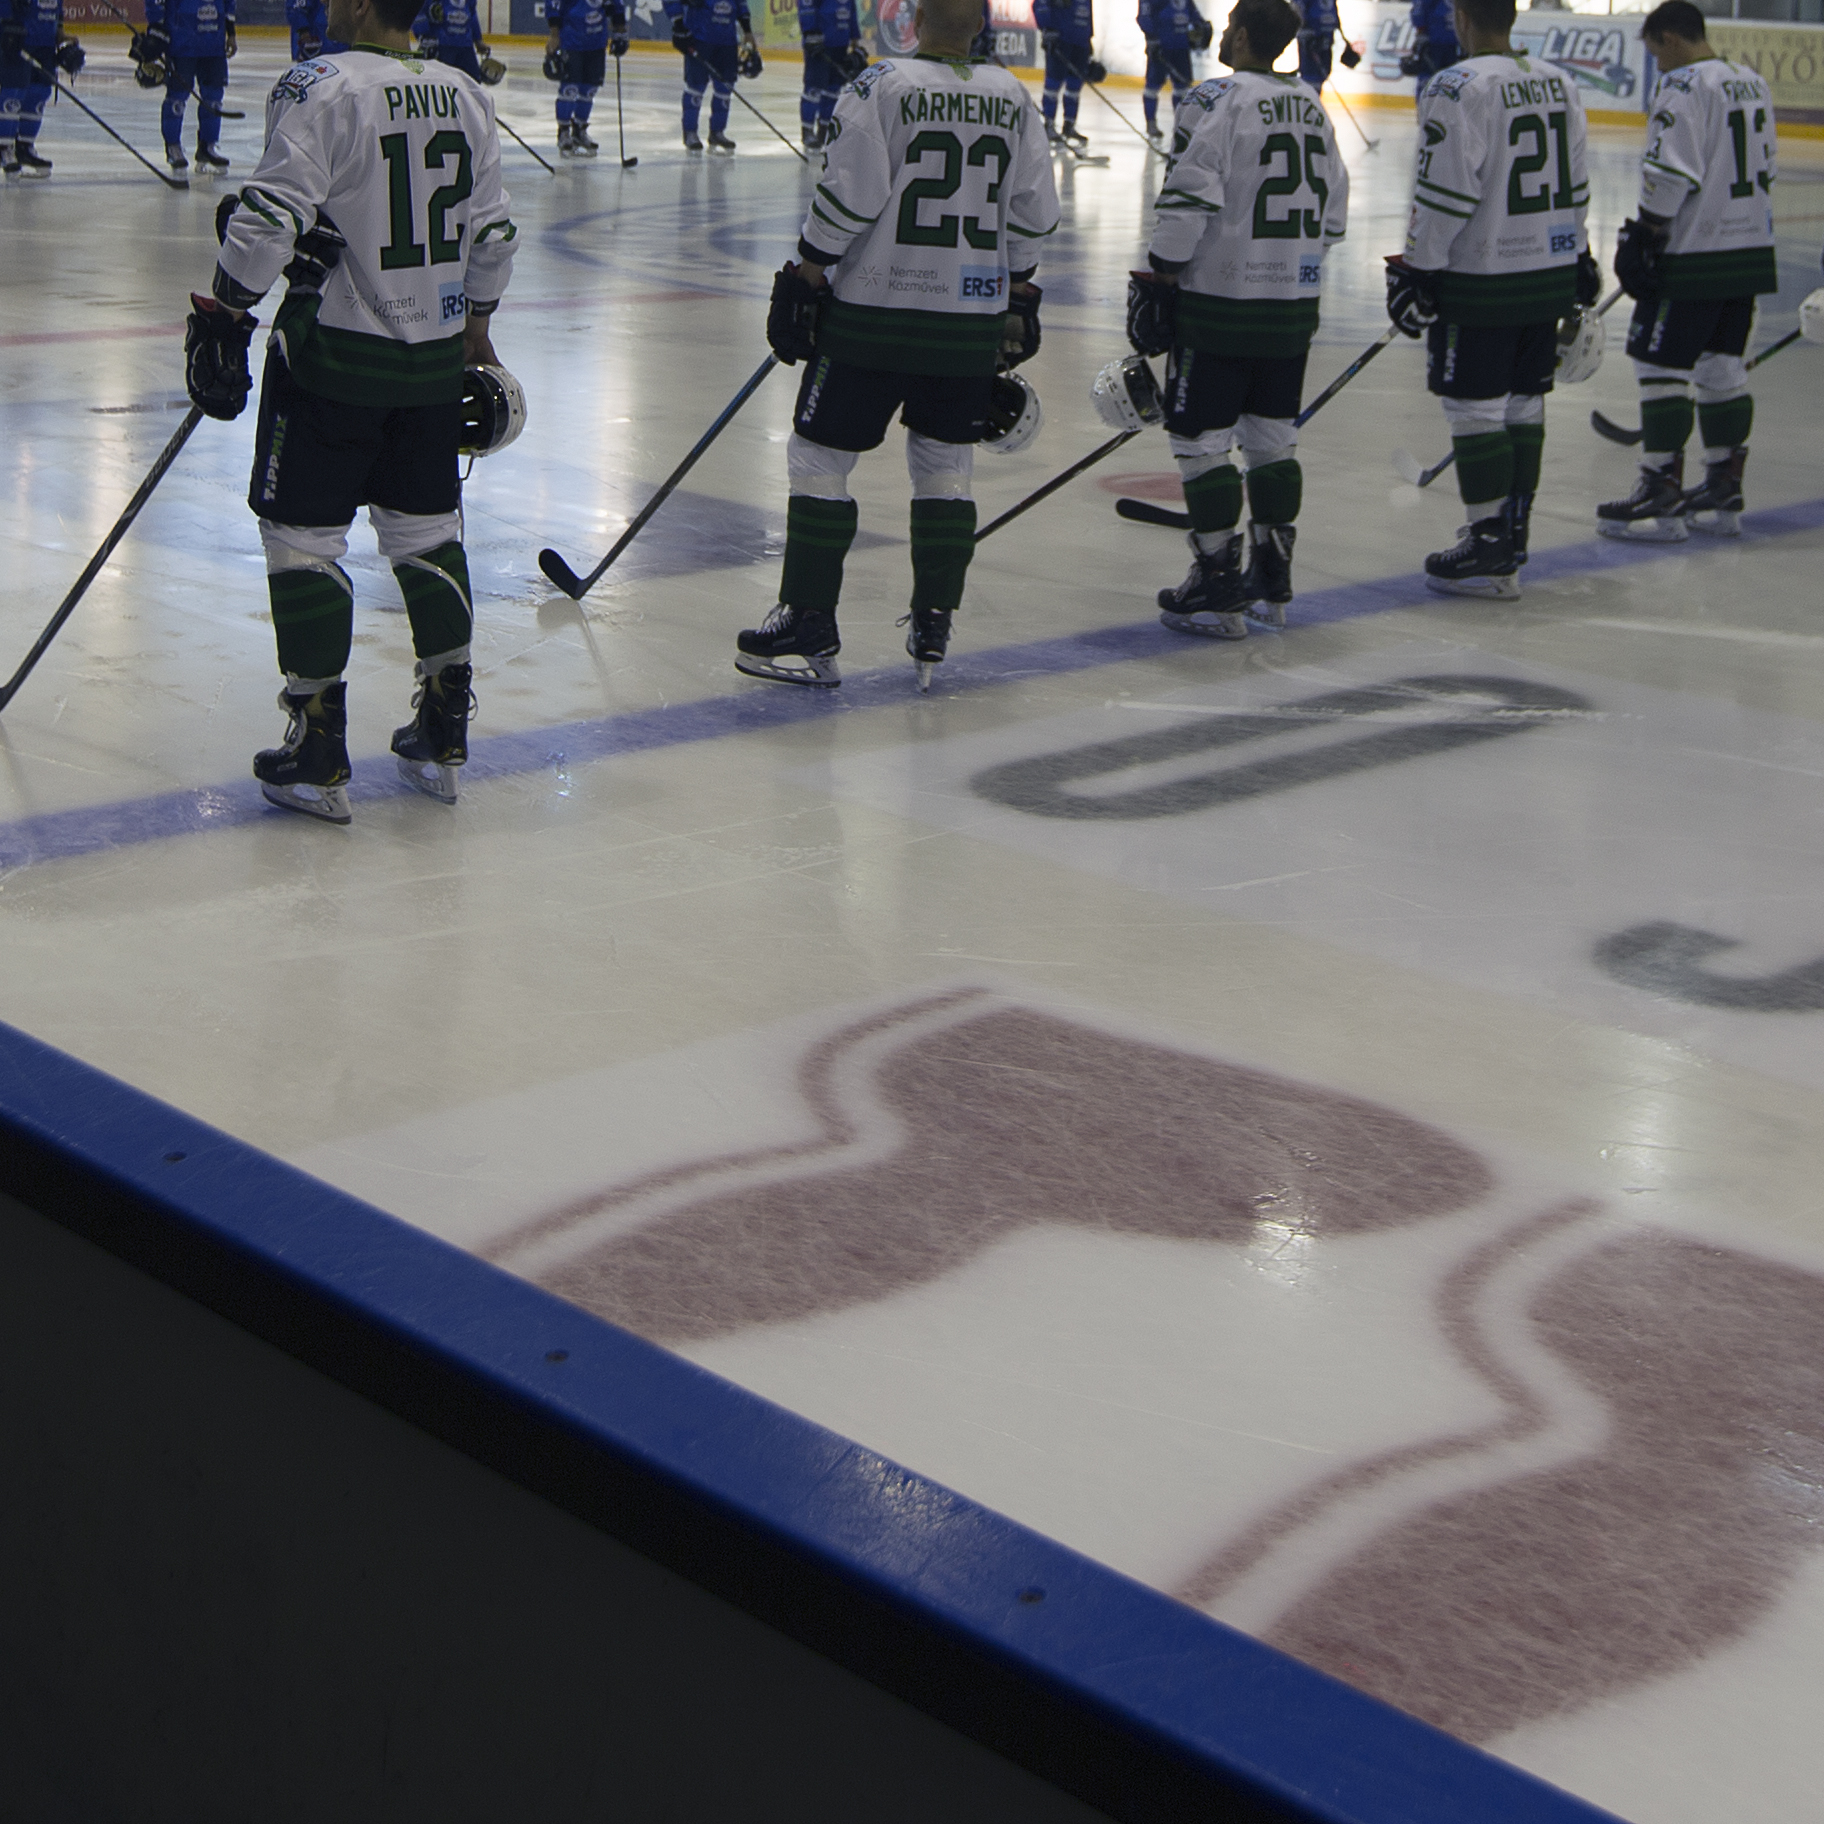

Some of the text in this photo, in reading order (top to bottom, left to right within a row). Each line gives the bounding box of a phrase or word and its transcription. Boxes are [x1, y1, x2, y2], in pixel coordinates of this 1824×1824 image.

[1540, 27, 1626, 64] LIGA
[379, 129, 473, 270] 12
[895, 130, 1012, 251] 23
[1252, 132, 1329, 240] 25
[1507, 111, 1574, 216] 21
[888, 280, 950, 295] Közművek
[889, 266, 939, 279] Nemzeti
